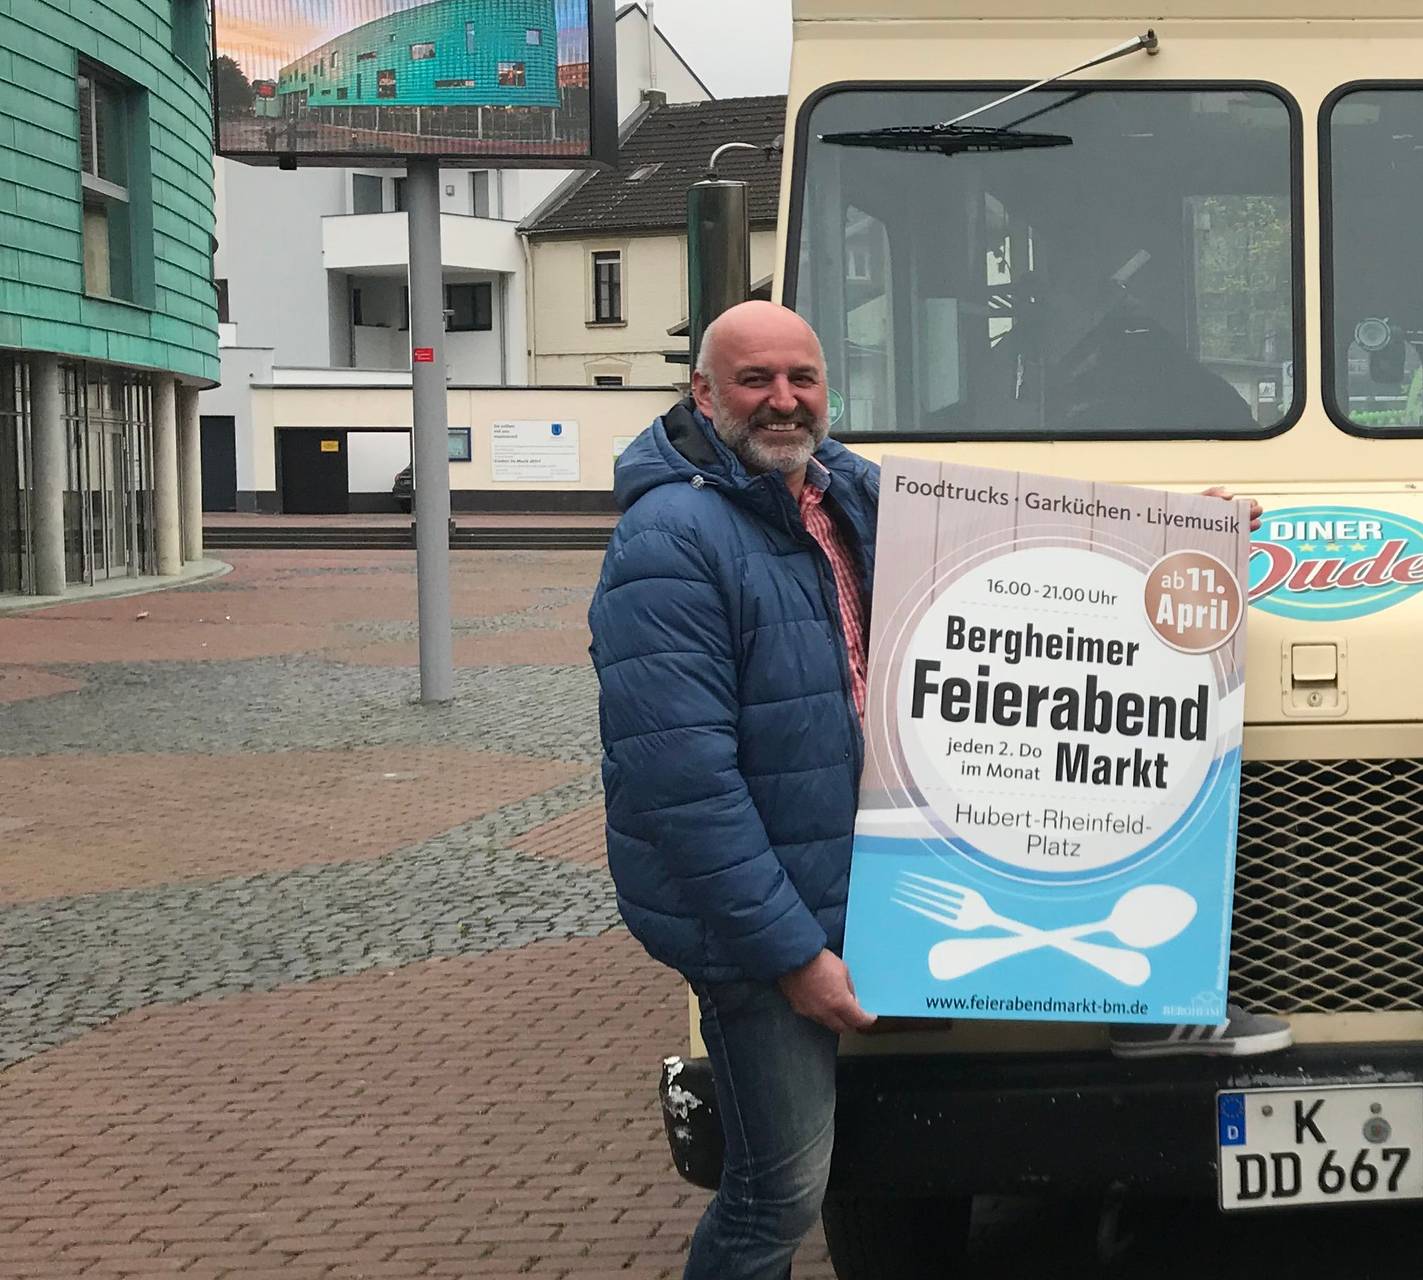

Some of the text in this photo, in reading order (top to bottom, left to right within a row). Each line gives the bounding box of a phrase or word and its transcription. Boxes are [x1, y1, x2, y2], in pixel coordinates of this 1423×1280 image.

[895, 475, 1240, 534] Foodtrucks Garküchen Livemusik
[1269, 520, 1384, 541] DINER
[1161, 567, 1225, 594] ab 11.
[1088, 590, 1118, 606] Uhr
[1156, 593, 1228, 634] April
[946, 615, 1139, 667] Bergheimer
[911, 659, 1209, 741] Feierabend
[946, 737, 1043, 759] jeden 2. Do
[961, 761, 1041, 781] im Monat
[1055, 742, 1169, 789] Markt
[955, 803, 1152, 835] Hubert-Rheinfeld-
[1027, 834, 1081, 857] Platz
[925, 994, 1149, 1016] www.feierabendmarkt-bm.de
[1227, 1126, 1239, 1140] D
[1295, 1099, 1327, 1144] K
[1236, 1148, 1411, 1200] DD 667
